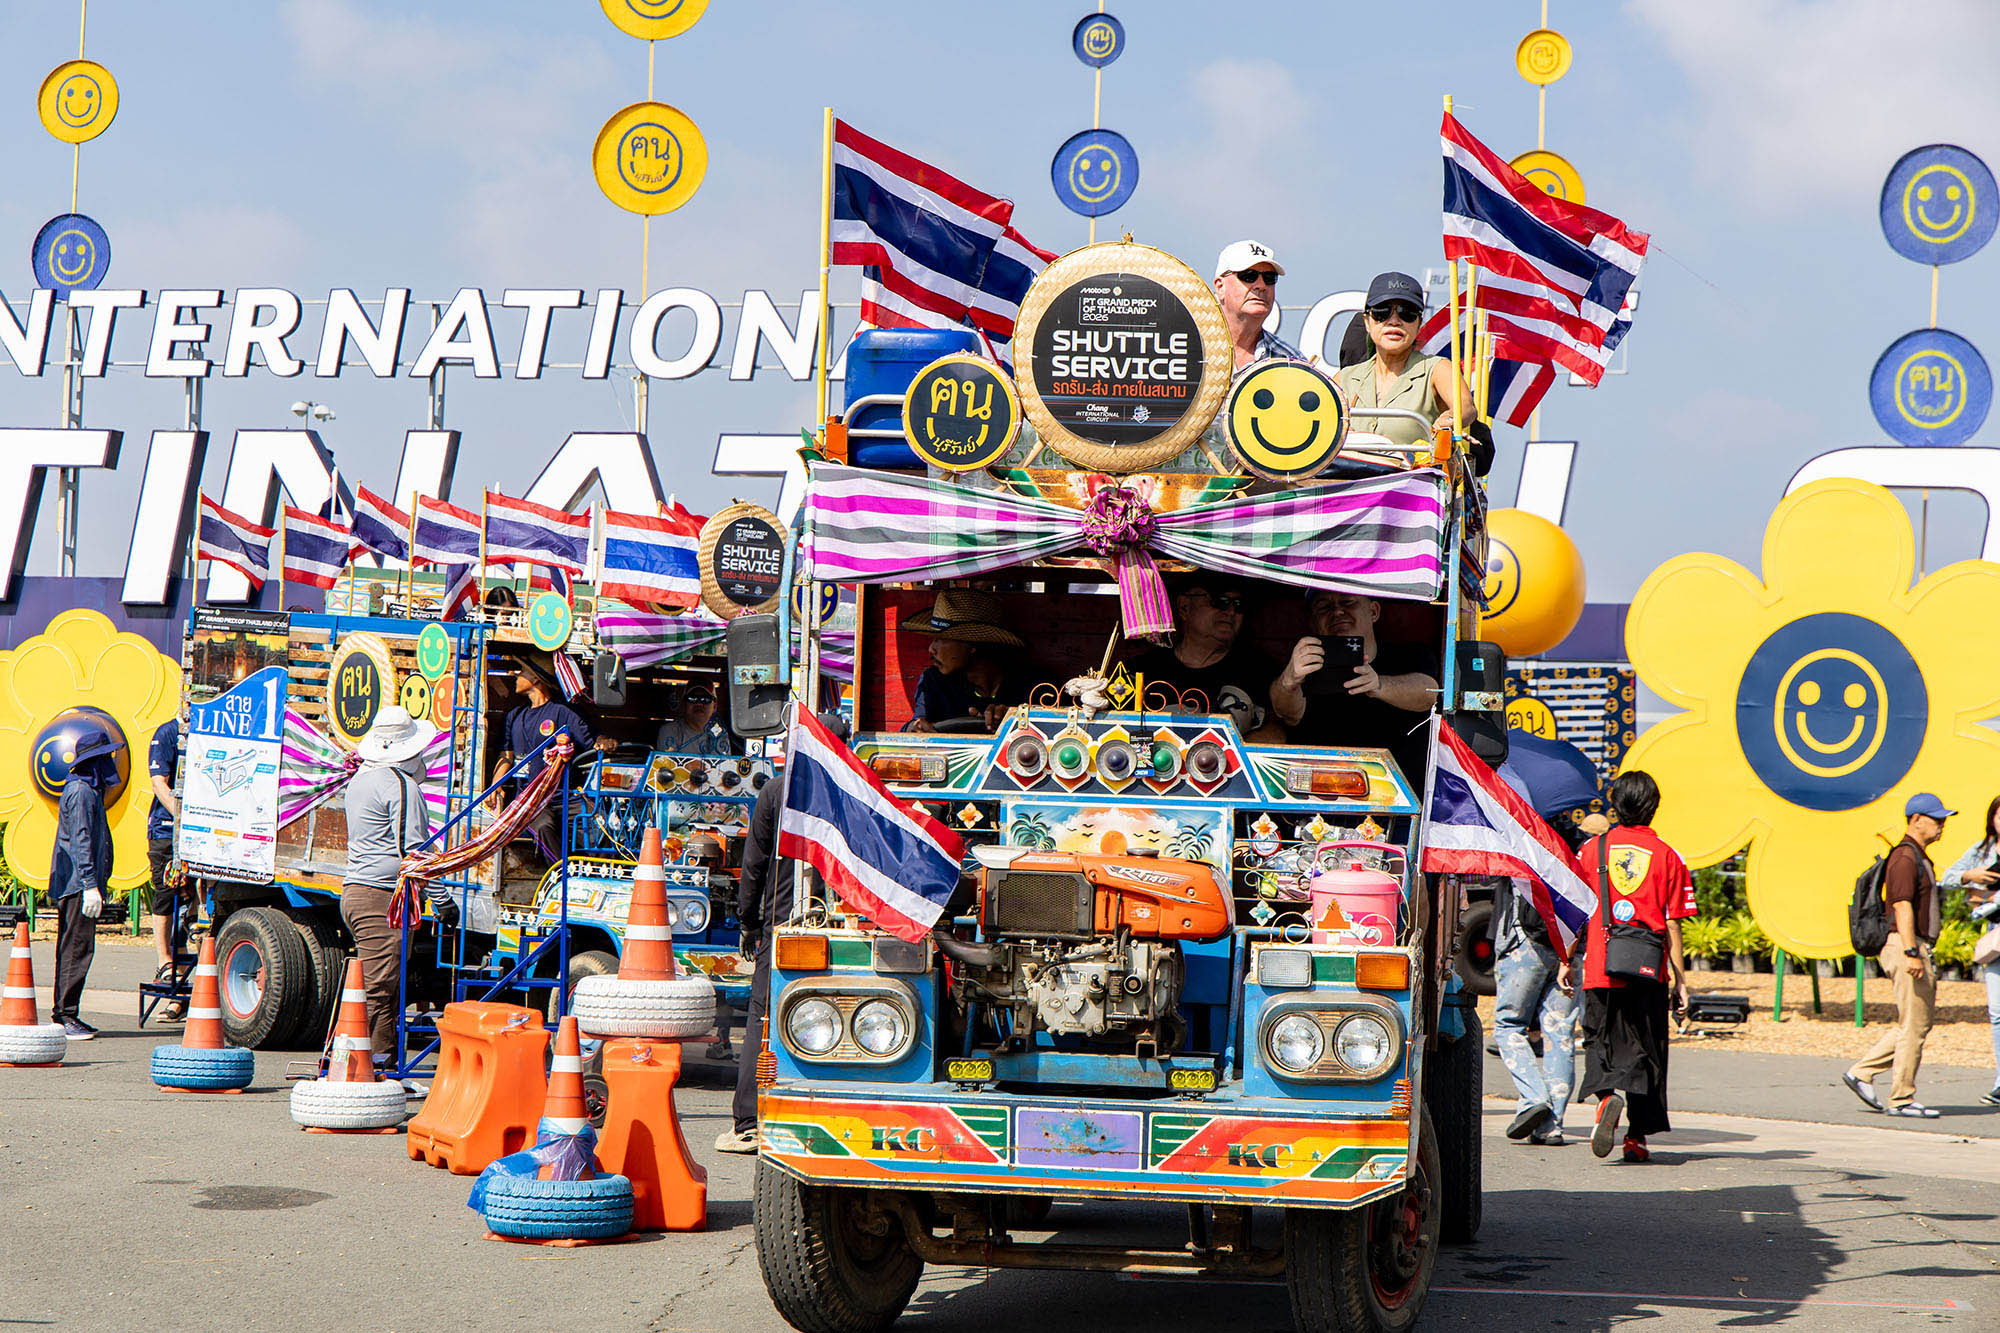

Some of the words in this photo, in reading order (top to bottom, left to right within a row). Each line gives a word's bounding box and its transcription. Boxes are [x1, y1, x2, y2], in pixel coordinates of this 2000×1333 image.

[1249, 243, 1267, 257] LA
[1083, 297, 1096, 306] PT
[1097, 298, 1131, 307] GRAND
[1133, 299, 1157, 308] PRIX
[1083, 305, 1095, 313] OF
[1097, 306, 1148, 315] THAILAND
[1082, 314, 1109, 322] 2026
[1052, 330, 1188, 355] SHUTTLE
[1051, 355, 1188, 381] SERVICE
[930, 376, 994, 420] ฅน
[1053, 379, 1109, 397] รถรับ-ส่ง
[1112, 380, 1187, 398] ภายในสนาม
[932, 435, 977, 456] บุรีรัมย์
[722, 544, 781, 561] SHUTTLE
[721, 557, 780, 575] SERVICE
[225, 694, 252, 713] สาย
[258, 677, 280, 740] 1
[195, 708, 252, 737] LINE
[1615, 901, 1632, 920] hp
[871, 1126, 936, 1152] KC
[1227, 1142, 1295, 1169] KC
